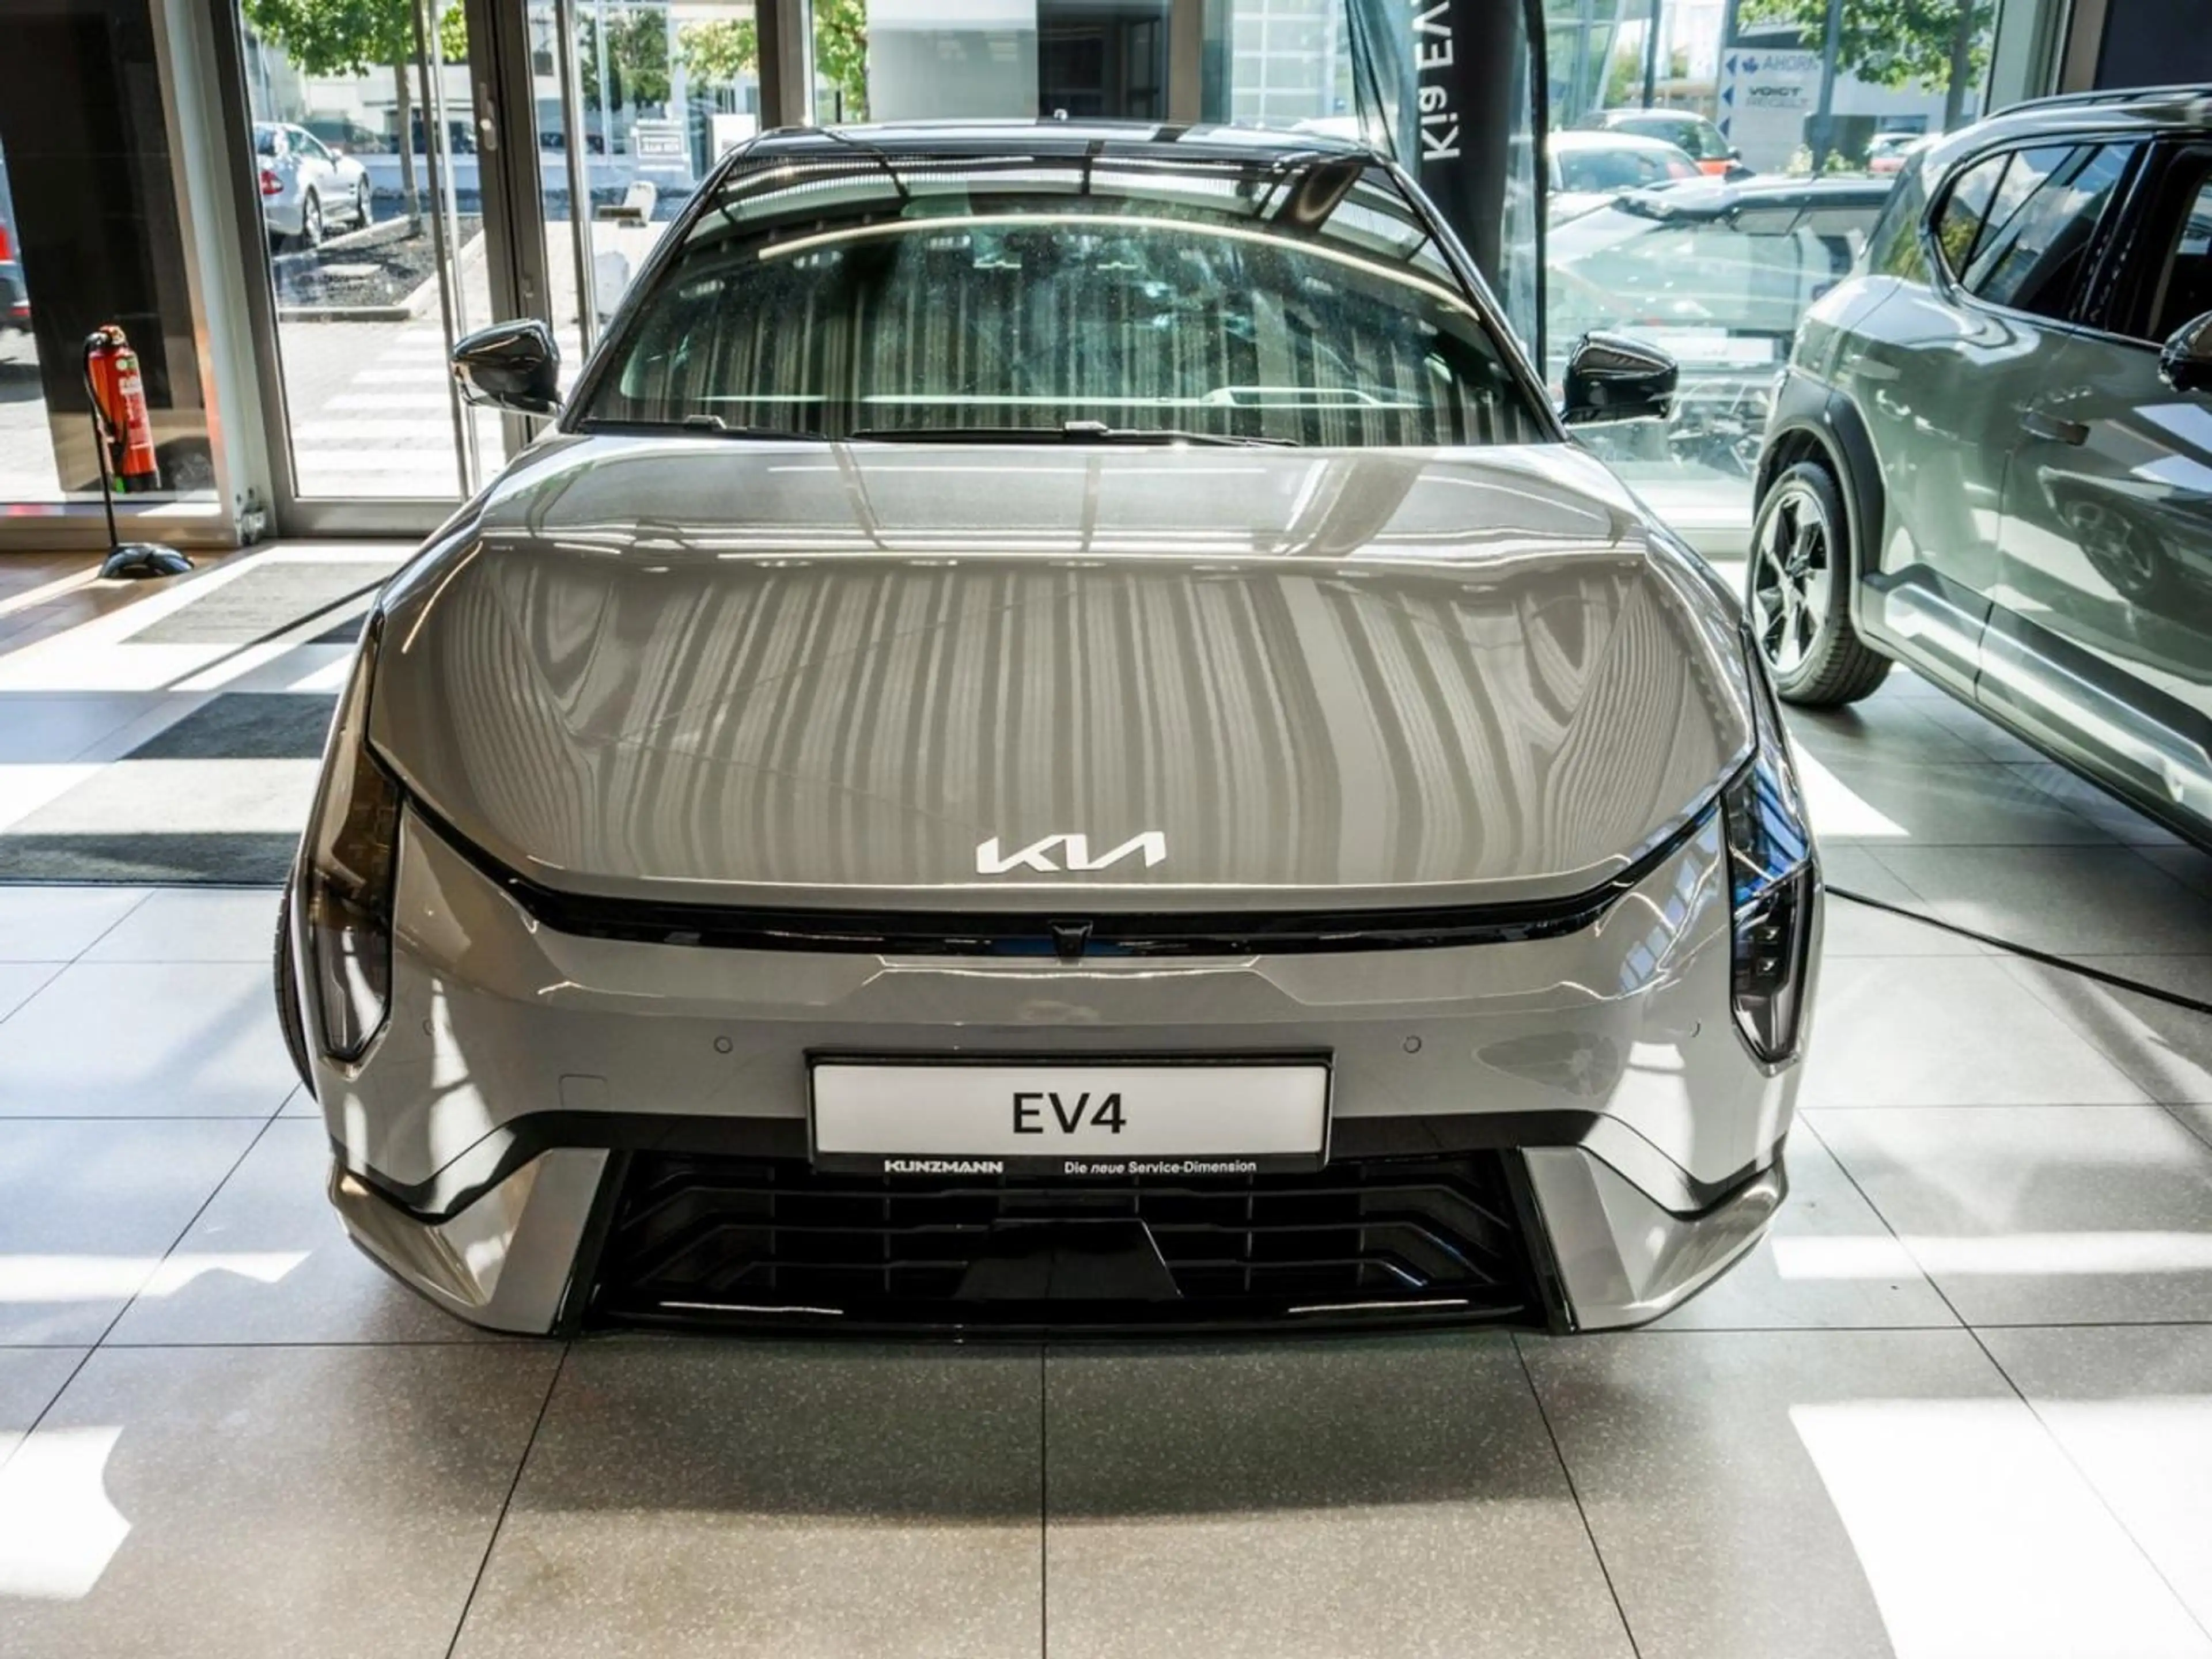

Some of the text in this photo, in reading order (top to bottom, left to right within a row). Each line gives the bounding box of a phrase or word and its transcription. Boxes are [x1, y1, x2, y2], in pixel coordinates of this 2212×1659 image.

[1411, 0, 1461, 161] Kia EV
[1013, 1092, 1127, 1134] EV4
[884, 1160, 1257, 1174] KUNZMANN Die neue Service-Dimension
